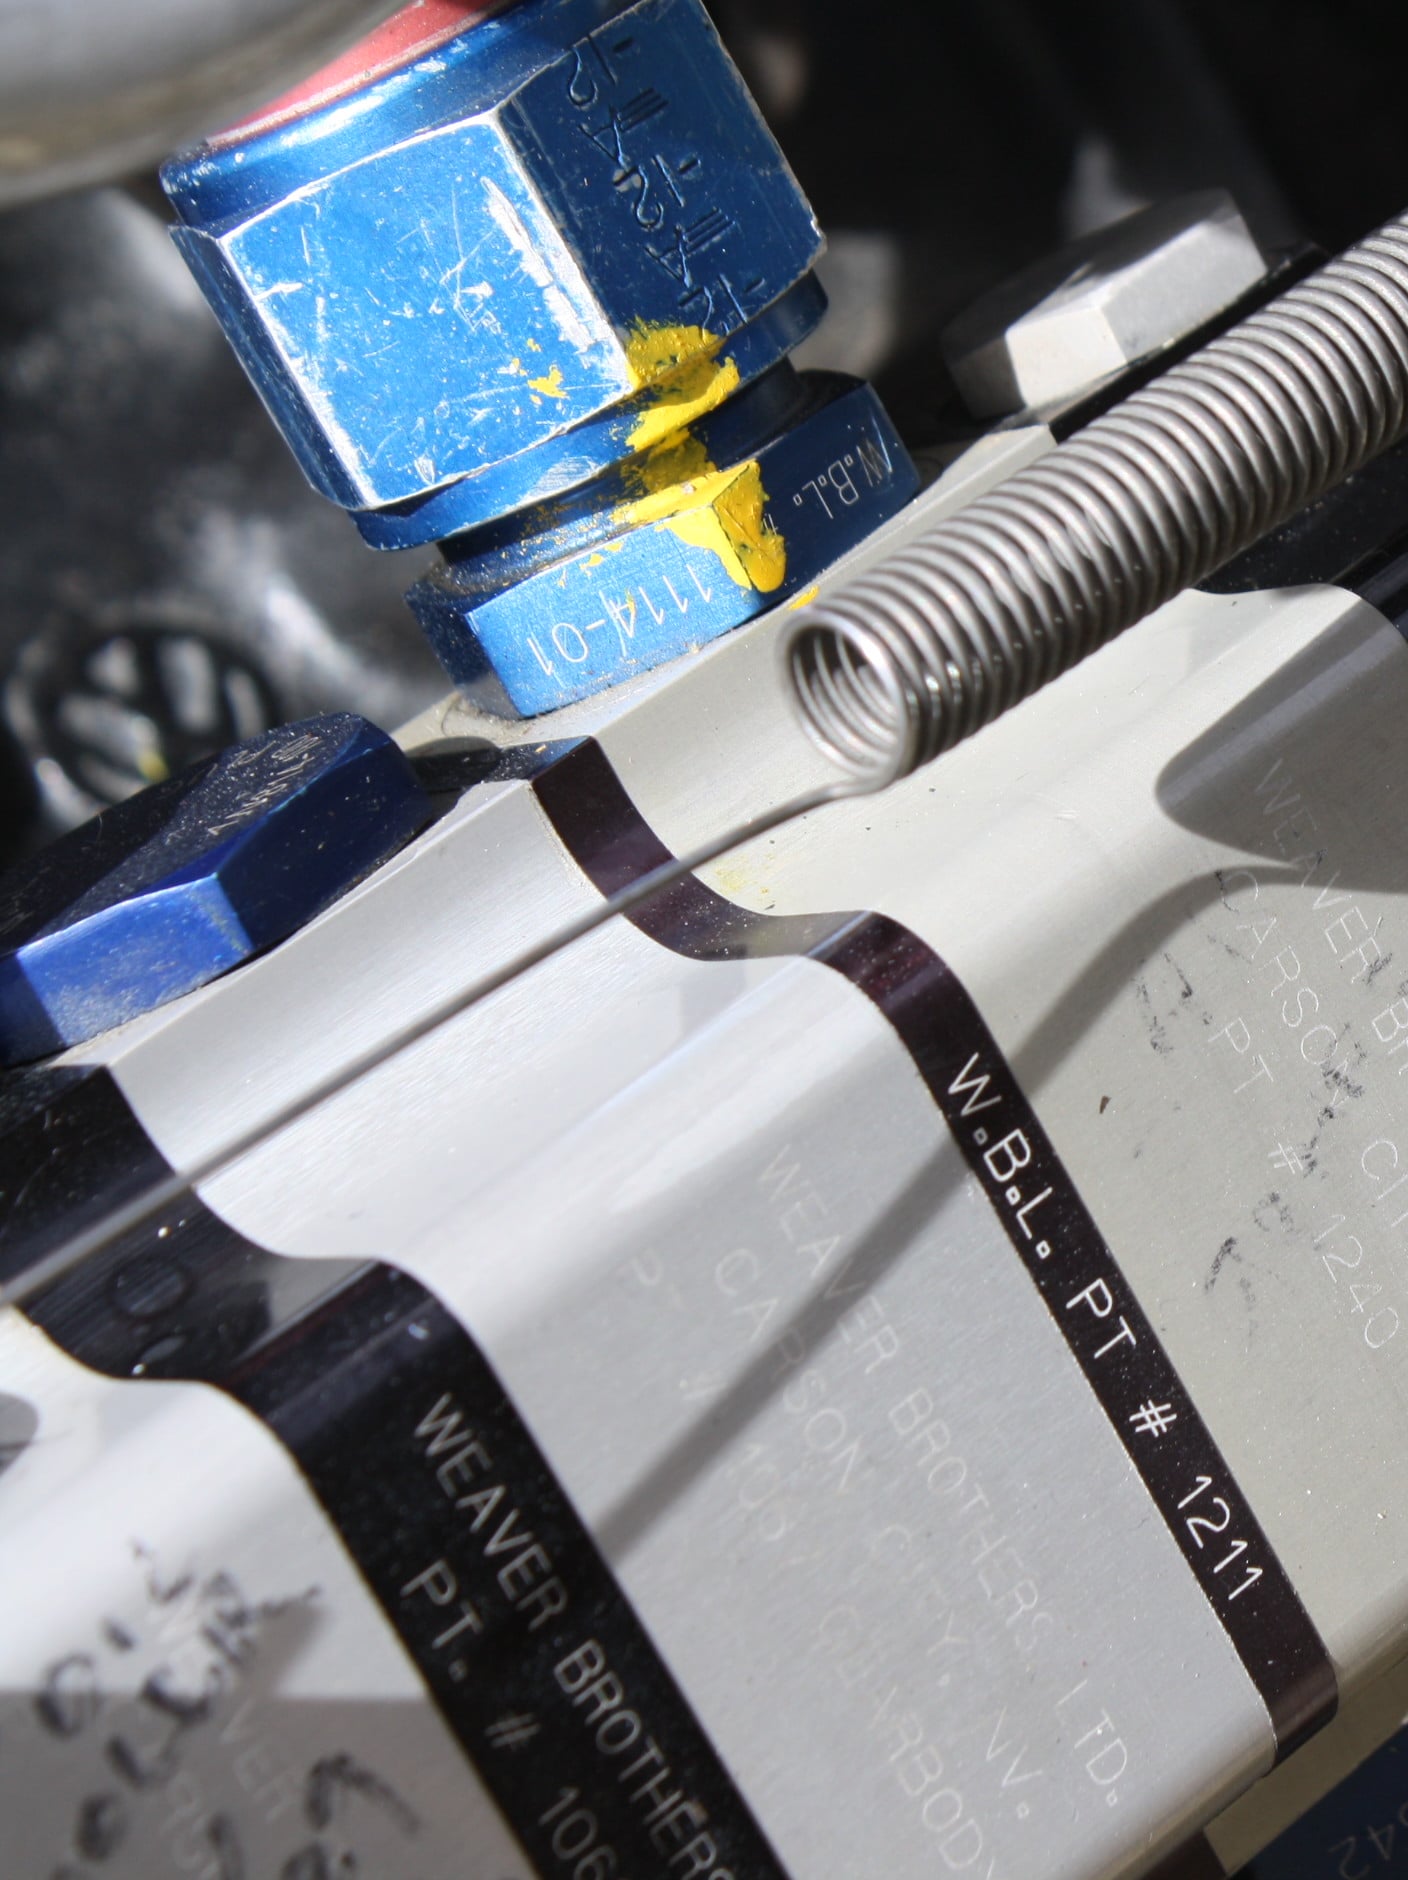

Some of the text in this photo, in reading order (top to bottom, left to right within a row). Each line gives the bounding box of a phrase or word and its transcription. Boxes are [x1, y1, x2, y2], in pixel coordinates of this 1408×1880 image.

[793, 438, 888, 519] W.B.L.
[526, 564, 713, 677] 1114-01
[1256, 758, 1385, 985] WEAVER
[1215, 867, 1362, 1110] CARSON
[756, 1143, 902, 1376] WEAVER
[1208, 1017, 1400, 1350] PT # 1240
[947, 1052, 1265, 1601] W.B.L. PT # 1211
[400, 1558, 484, 1683] PT.
[413, 1391, 569, 1631] WEAVER
